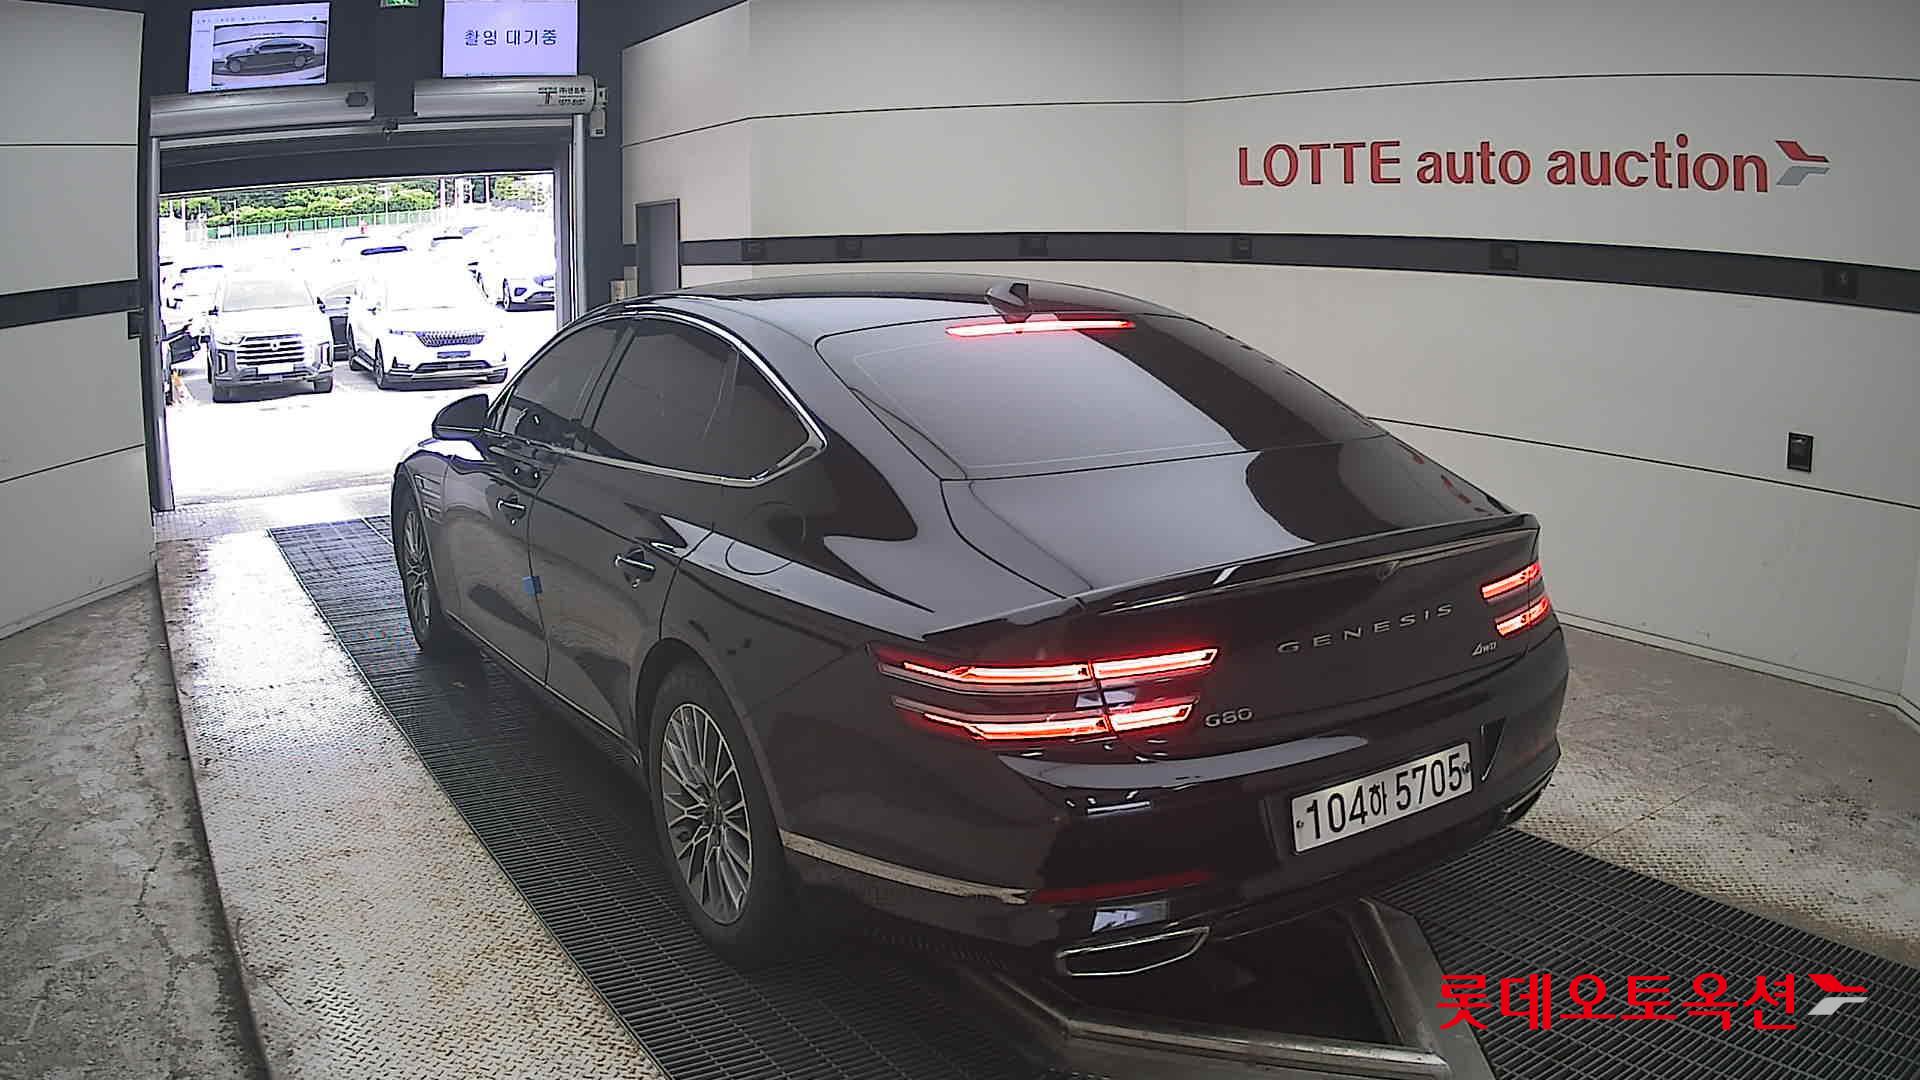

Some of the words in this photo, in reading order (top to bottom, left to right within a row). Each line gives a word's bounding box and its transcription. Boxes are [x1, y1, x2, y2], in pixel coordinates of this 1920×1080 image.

[464, 29, 497, 46] 촬영
[506, 29, 557, 46] 대기중
[1238, 140, 1400, 187] LOTTE
[1416, 141, 1531, 185] auto
[1546, 133, 1768, 192] auction
[1277, 603, 1453, 653] GENESIS
[1306, 781, 1388, 840] 104하
[1395, 752, 1463, 811] 5705
